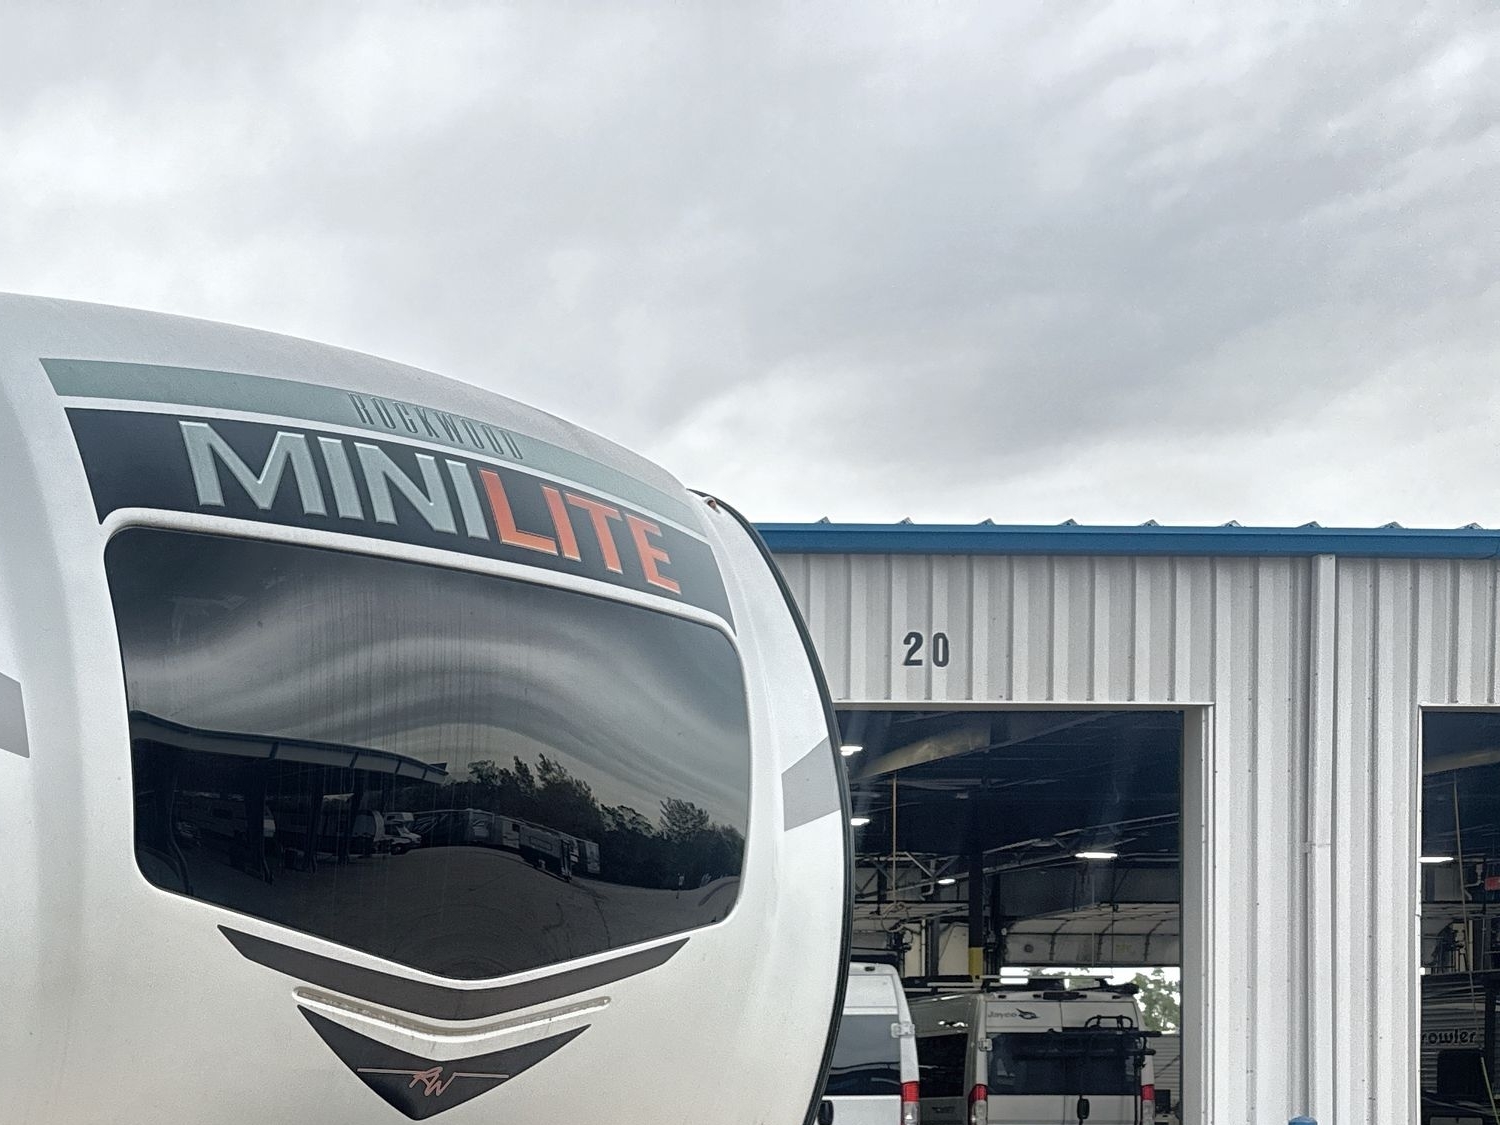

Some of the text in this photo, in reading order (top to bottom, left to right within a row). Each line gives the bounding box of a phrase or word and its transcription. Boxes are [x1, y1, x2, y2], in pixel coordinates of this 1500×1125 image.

[348, 392, 523, 460] ROCKWOOD
[902, 631, 949, 667] 20
[1421, 1028, 1477, 1044] rowler
